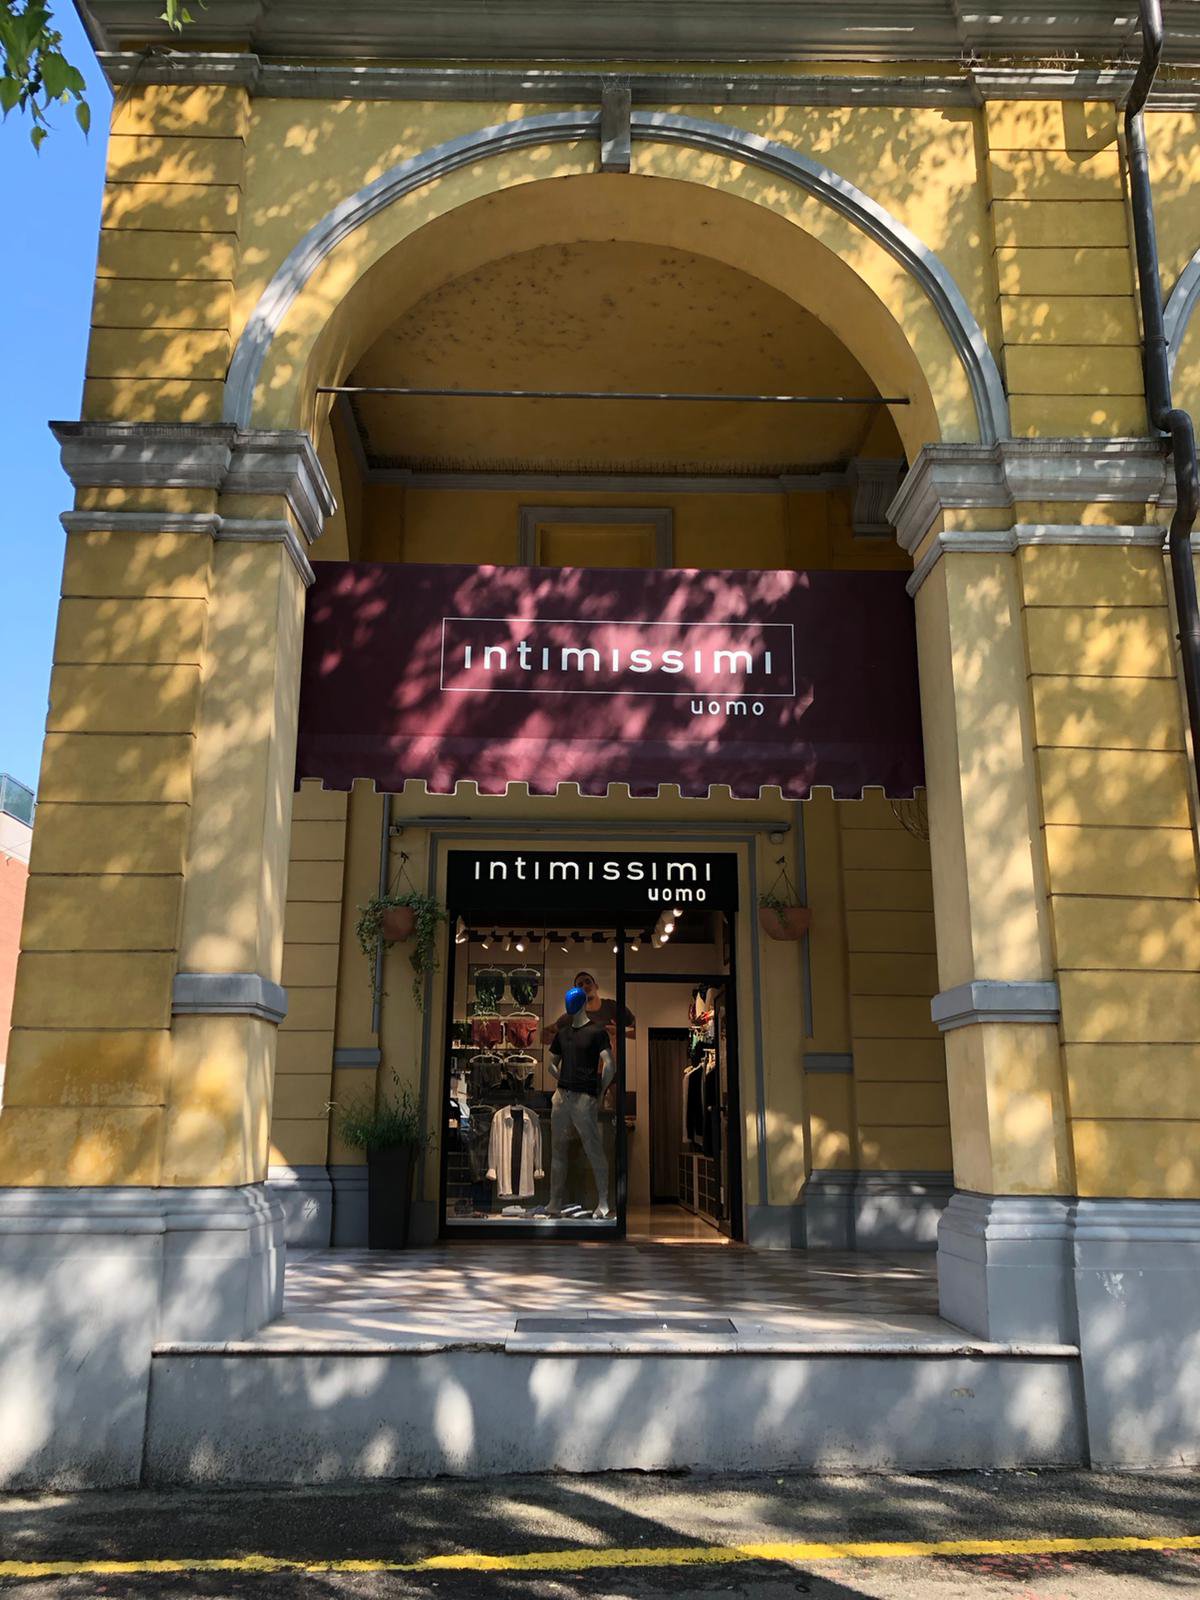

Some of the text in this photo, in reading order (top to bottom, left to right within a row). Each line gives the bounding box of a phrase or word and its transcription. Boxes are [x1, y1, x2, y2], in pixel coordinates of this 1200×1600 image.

[464, 640, 773, 675] intimissimi
[690, 699, 765, 715] uomo
[474, 856, 711, 881] intimissimi
[647, 887, 706, 902] uomo
